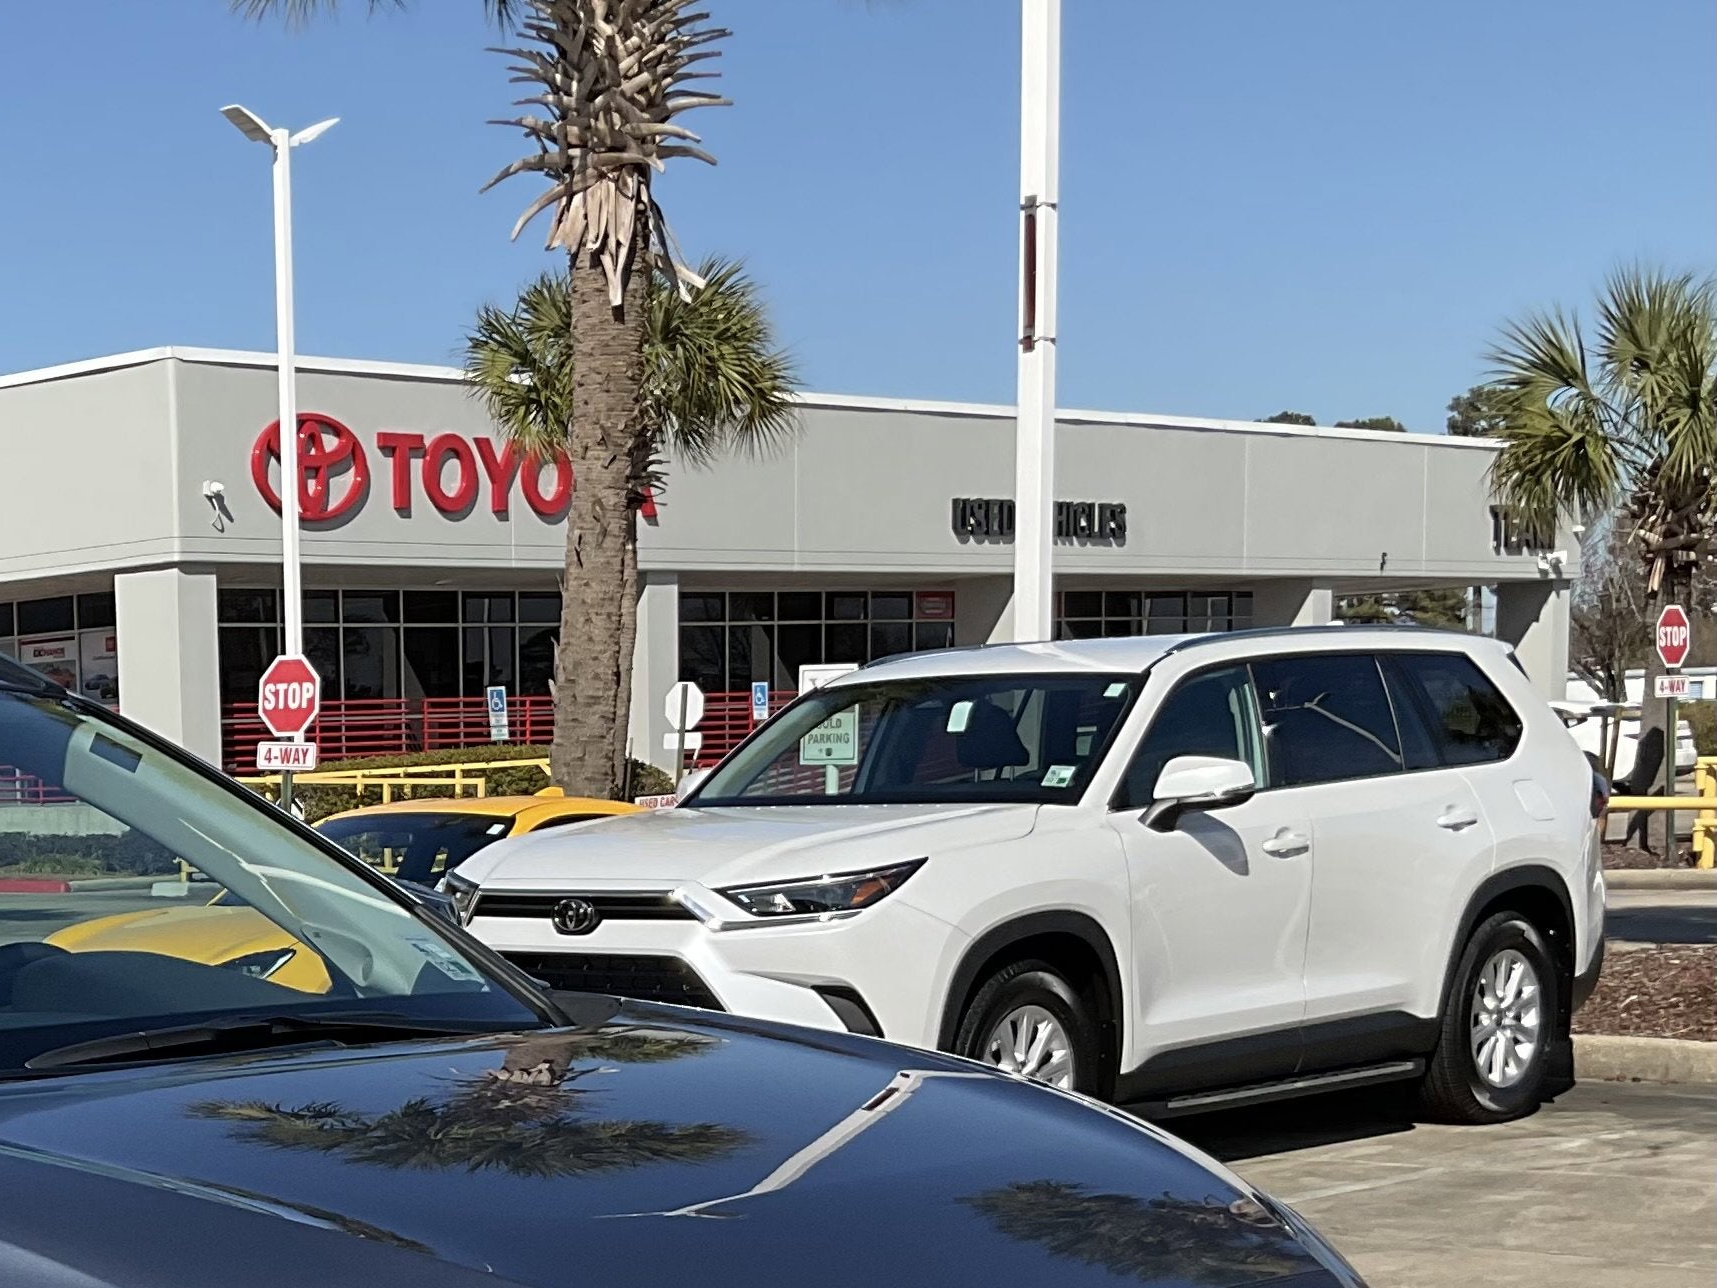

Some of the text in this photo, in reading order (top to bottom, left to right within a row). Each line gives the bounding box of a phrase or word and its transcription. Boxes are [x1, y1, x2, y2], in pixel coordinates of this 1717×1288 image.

[377, 432, 658, 518] TOYO
[951, 498, 1127, 541] USED HICLES
[1659, 625, 1687, 647] STOP
[263, 682, 315, 710] STOP
[1659, 680, 1686, 693] 4-WAY
[807, 732, 851, 745] PARKING
[263, 746, 310, 765] 4-WAY
